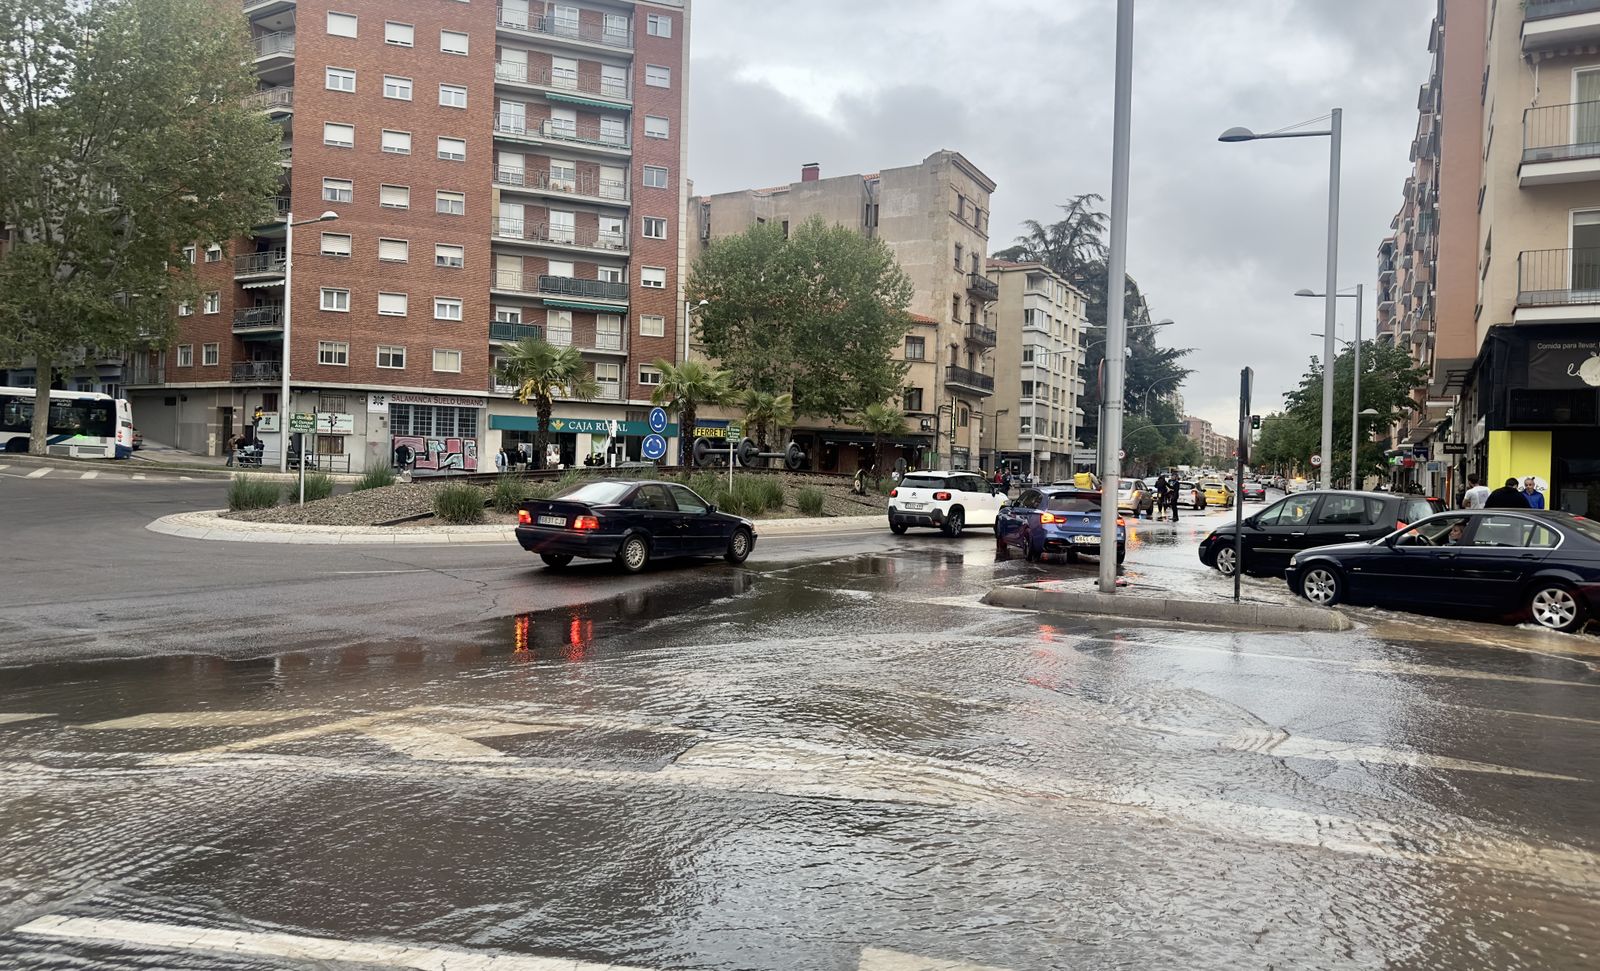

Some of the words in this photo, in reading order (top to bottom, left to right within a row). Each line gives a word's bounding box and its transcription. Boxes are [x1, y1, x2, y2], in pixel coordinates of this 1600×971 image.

[391, 393, 432, 404] SALAMANCA
[433, 396, 456, 405] SUELO
[456, 397, 484, 406] URBANO
[568, 421, 593, 432] CAJA
